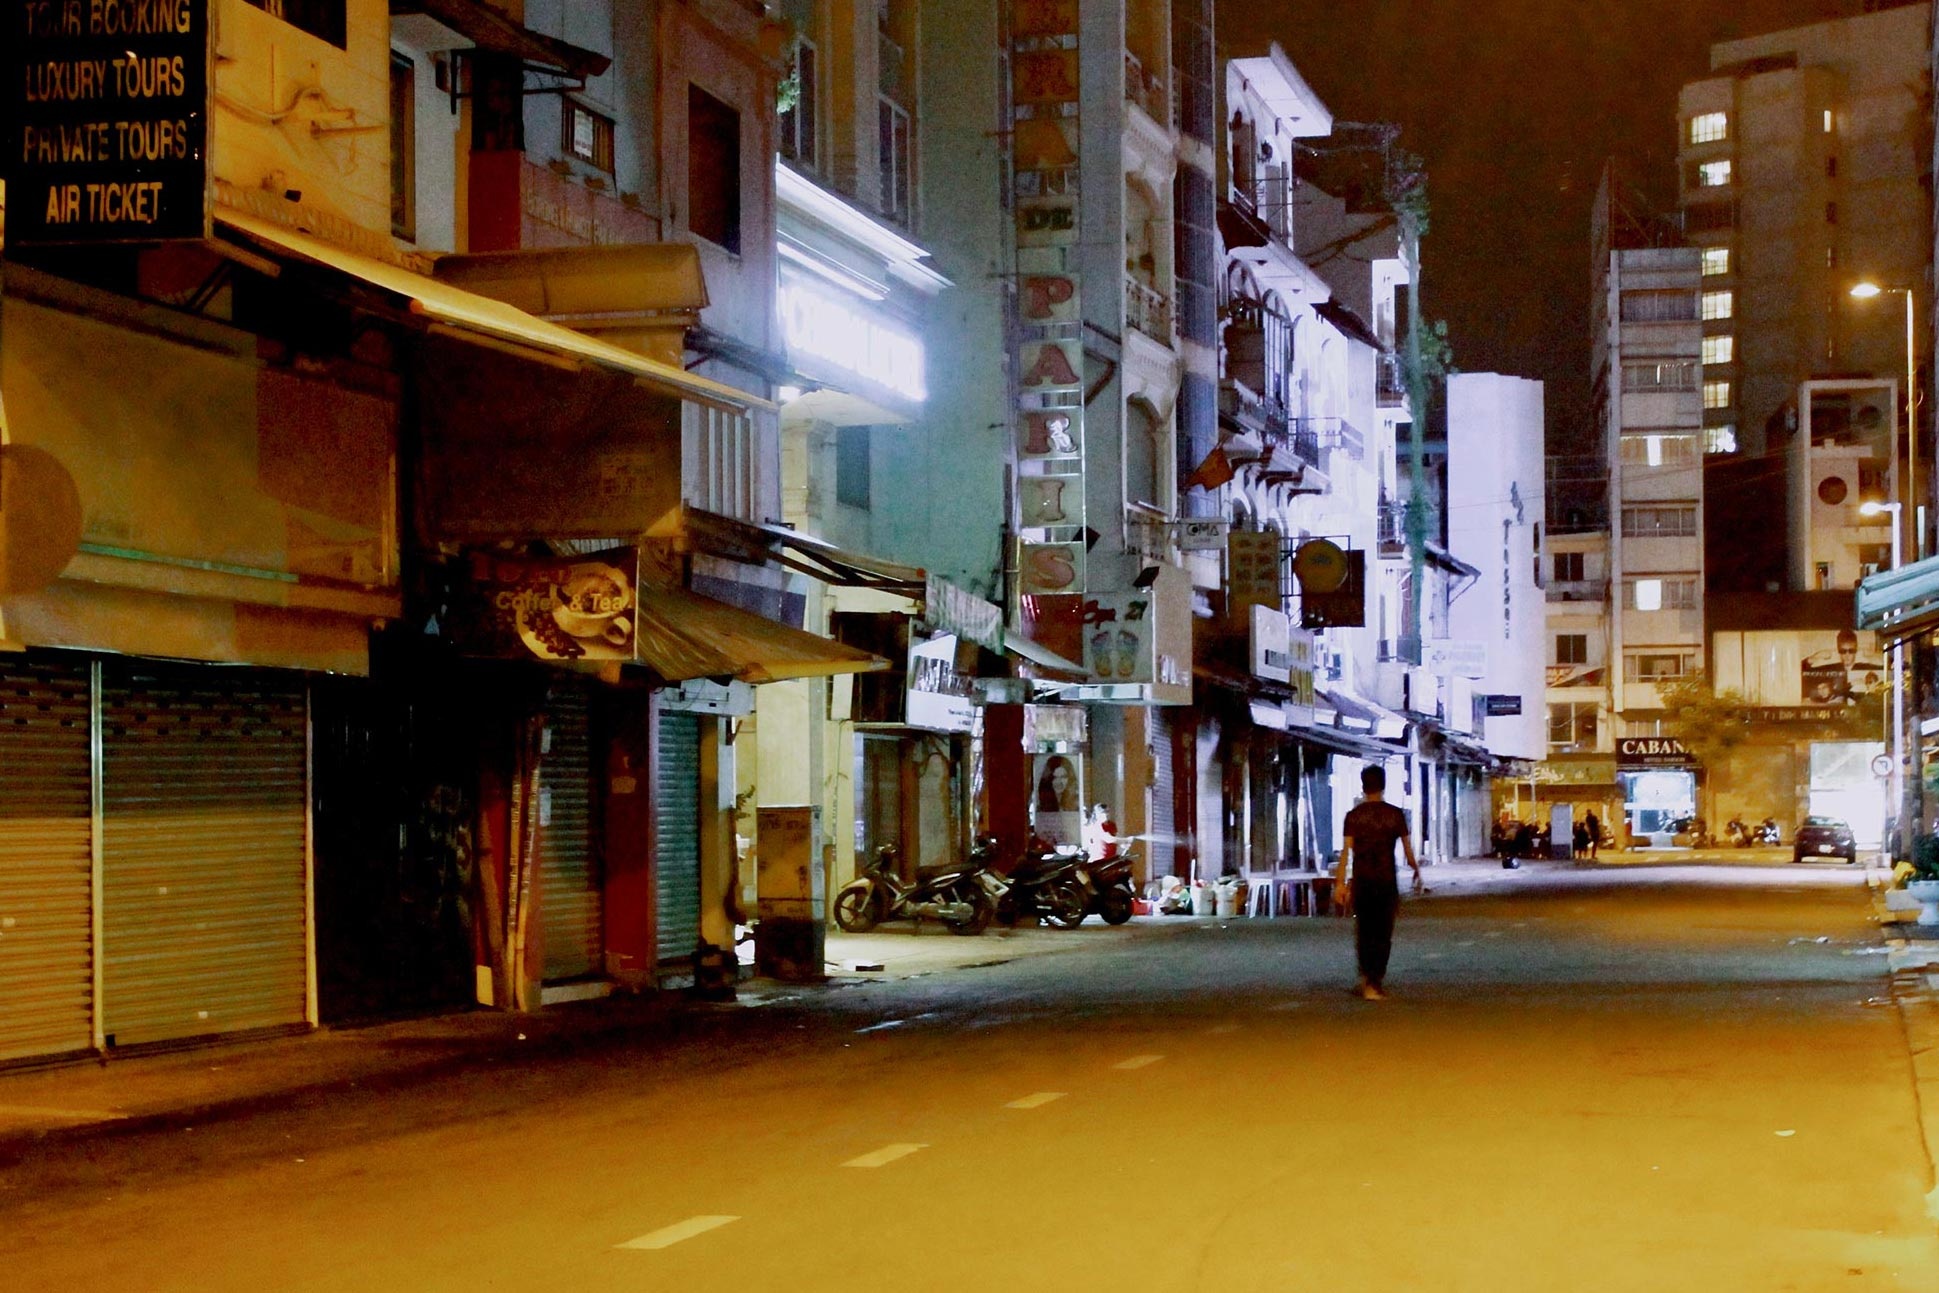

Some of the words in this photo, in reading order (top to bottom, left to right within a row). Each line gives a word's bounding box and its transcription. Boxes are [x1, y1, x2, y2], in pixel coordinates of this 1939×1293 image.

[25, 0, 81, 37] TOUR
[90, 0, 191, 36] BOOKING
[26, 59, 107, 101] LUXURY
[112, 55, 185, 98] TOURS
[23, 121, 110, 164] PRIVATE
[115, 118, 187, 161] TOURS
[45, 184, 81, 224] AIR
[86, 181, 163, 224] TICKET
[570, 594, 582, 612] &
[590, 593, 623, 612] Tea
[1622, 740, 1689, 755] CABAN
